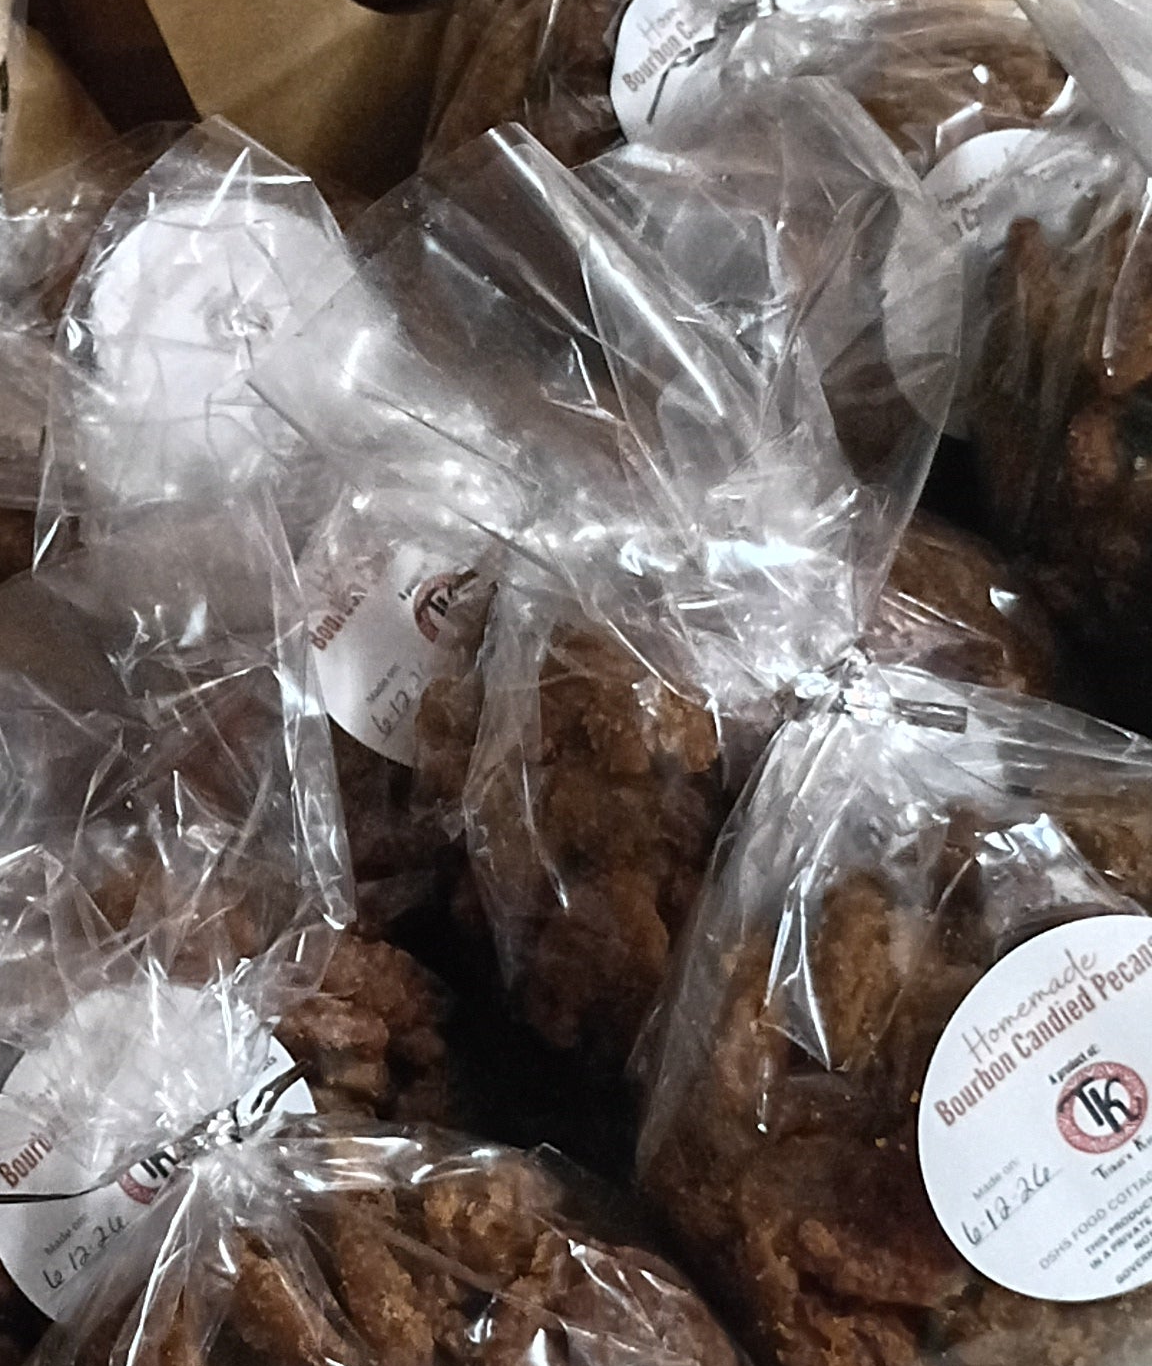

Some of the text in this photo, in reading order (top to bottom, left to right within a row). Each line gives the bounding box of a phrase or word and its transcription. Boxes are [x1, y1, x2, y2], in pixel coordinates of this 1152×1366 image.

[933, 1049, 1018, 1127] Bourbon
[1011, 983, 1097, 1061] Candied
[962, 948, 1098, 1065] Homemade
